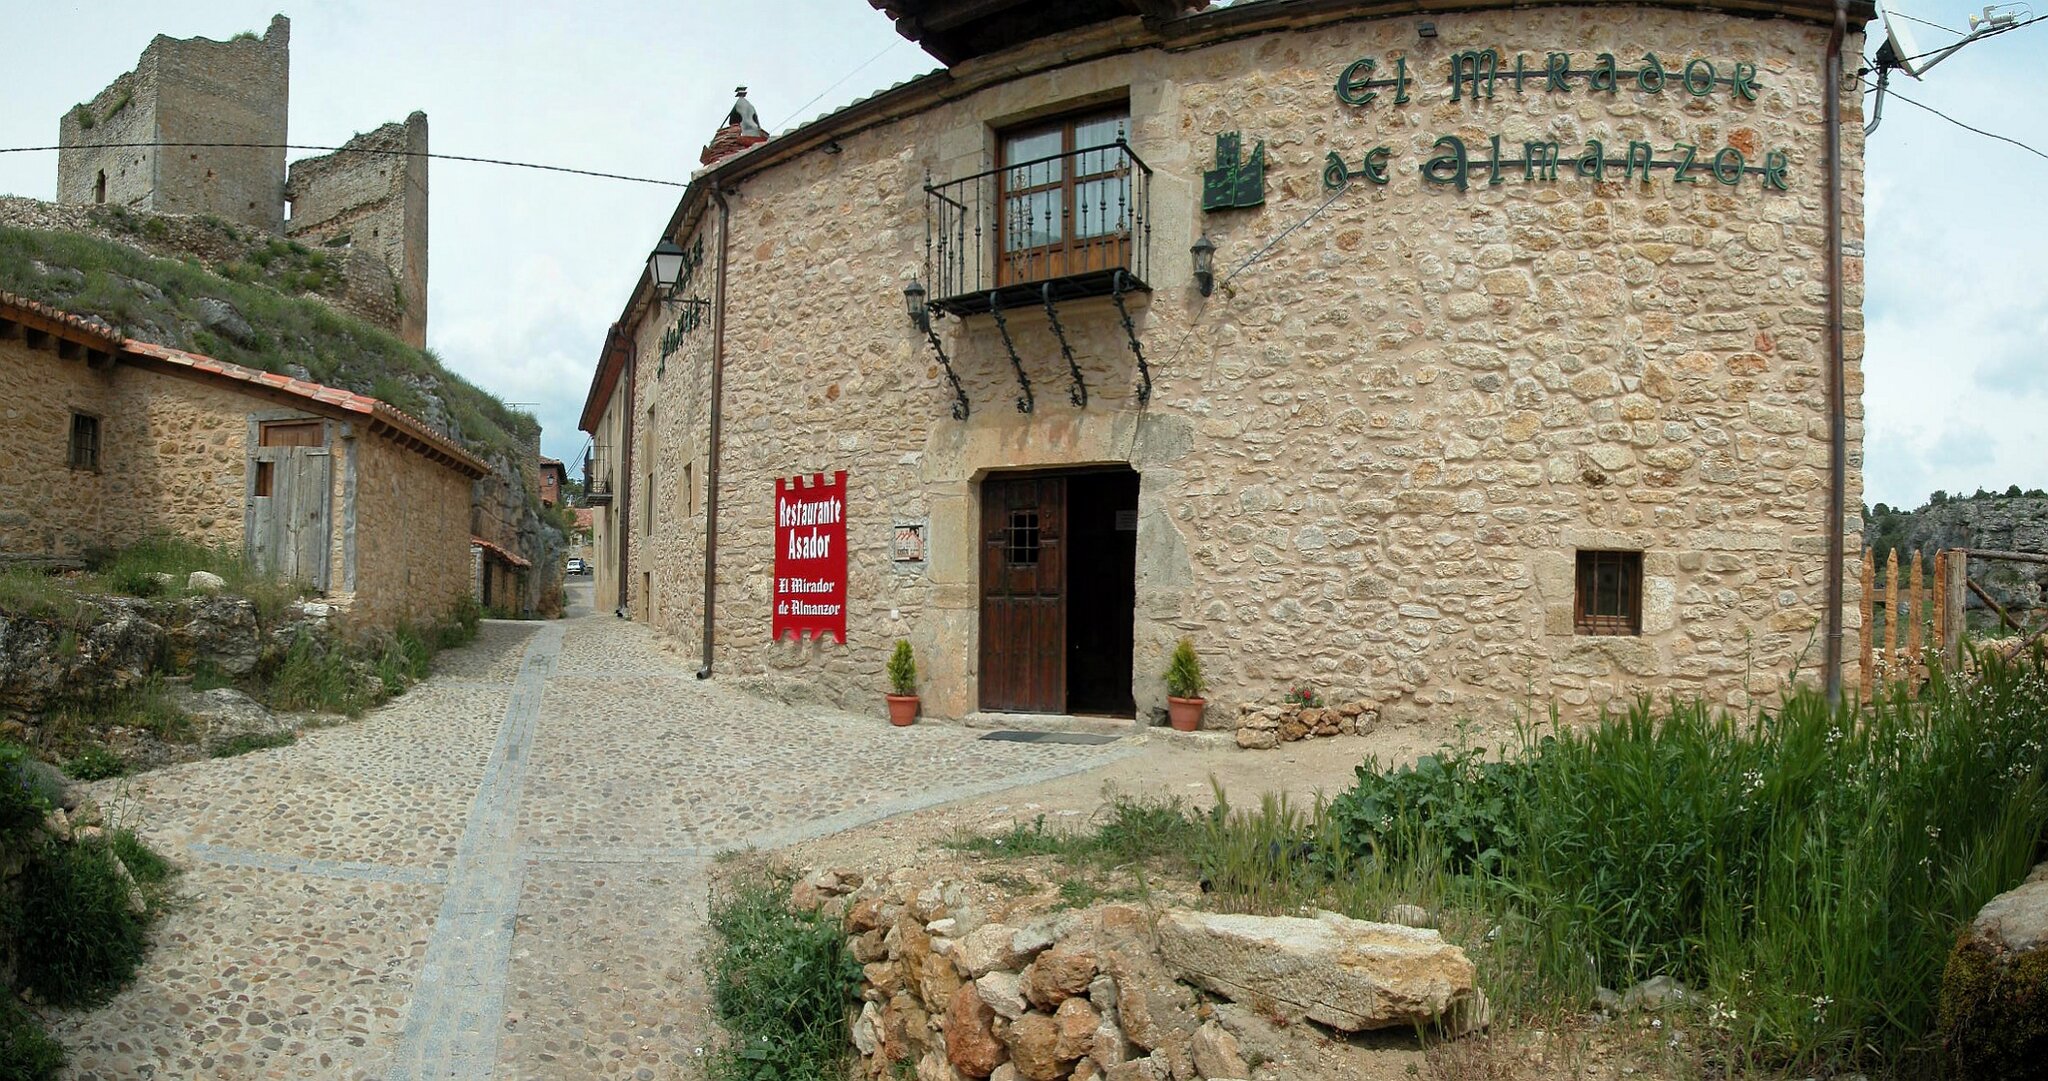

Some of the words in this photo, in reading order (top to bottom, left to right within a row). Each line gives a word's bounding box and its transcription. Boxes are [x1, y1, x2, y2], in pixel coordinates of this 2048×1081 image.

[780, 495, 841, 528] Restaurante
[788, 527, 831, 560] Asador
[778, 578, 789, 594] El
[791, 577, 835, 594] Mirador
[778, 600, 789, 616] de
[791, 599, 841, 616] Almanzor
